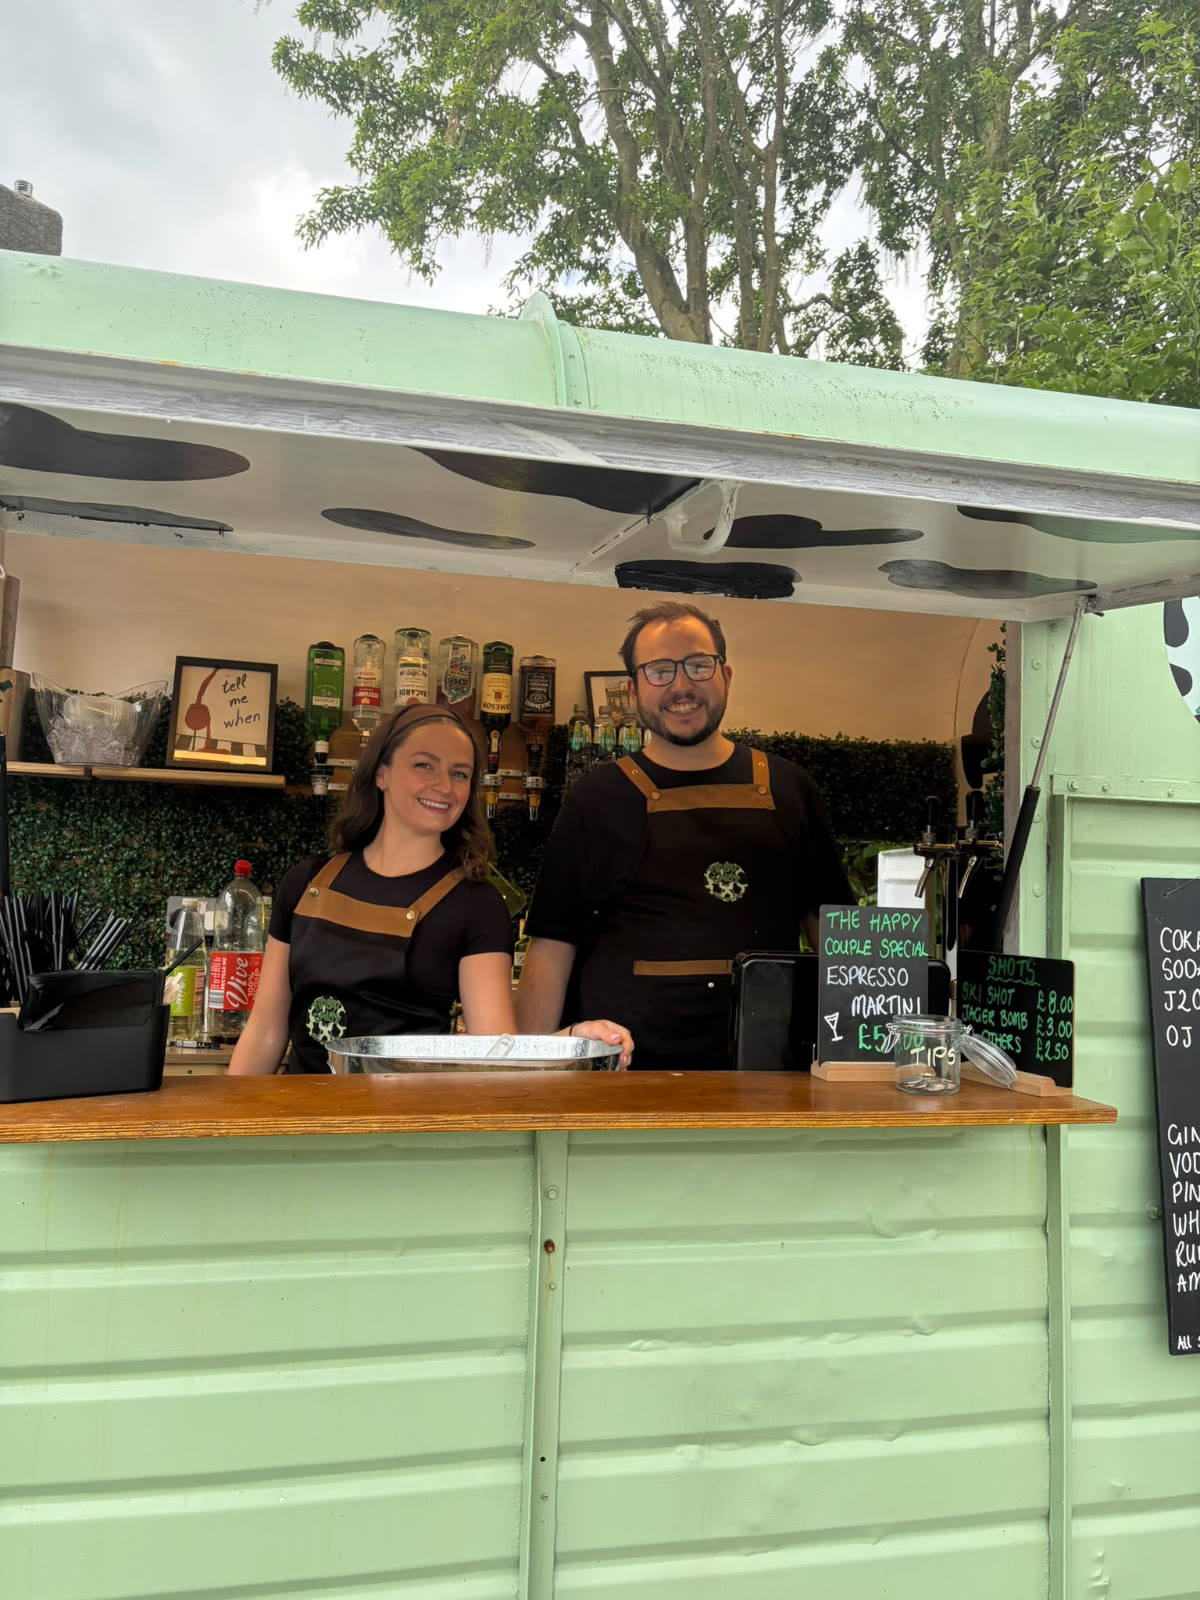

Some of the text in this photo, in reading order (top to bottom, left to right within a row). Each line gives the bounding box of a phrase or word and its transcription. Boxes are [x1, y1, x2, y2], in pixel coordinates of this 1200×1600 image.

[221, 673, 248, 694] tell
[229, 695, 249, 707] me
[223, 709, 261, 729] when
[826, 910, 922, 933] THE HAPPY
[824, 938, 929, 959] COUPLE SPECIAL
[826, 965, 909, 987] ESPRESSO
[988, 955, 1036, 983] SHOTS
[225, 957, 249, 1009] Vive
[247, 971, 255, 997] 100%
[851, 994, 921, 1018] MARTINI
[962, 981, 1073, 1015] SKI SHOT £8.00
[962, 1004, 1073, 1038] JAGER BOMB £3.00
[858, 1023, 924, 1053] £500
[1166, 1025, 1193, 1048] OJ
[910, 1046, 956, 1067] TIPS
[1167, 1123, 1200, 1146] GIN
[1175, 1240, 1200, 1267] RU
